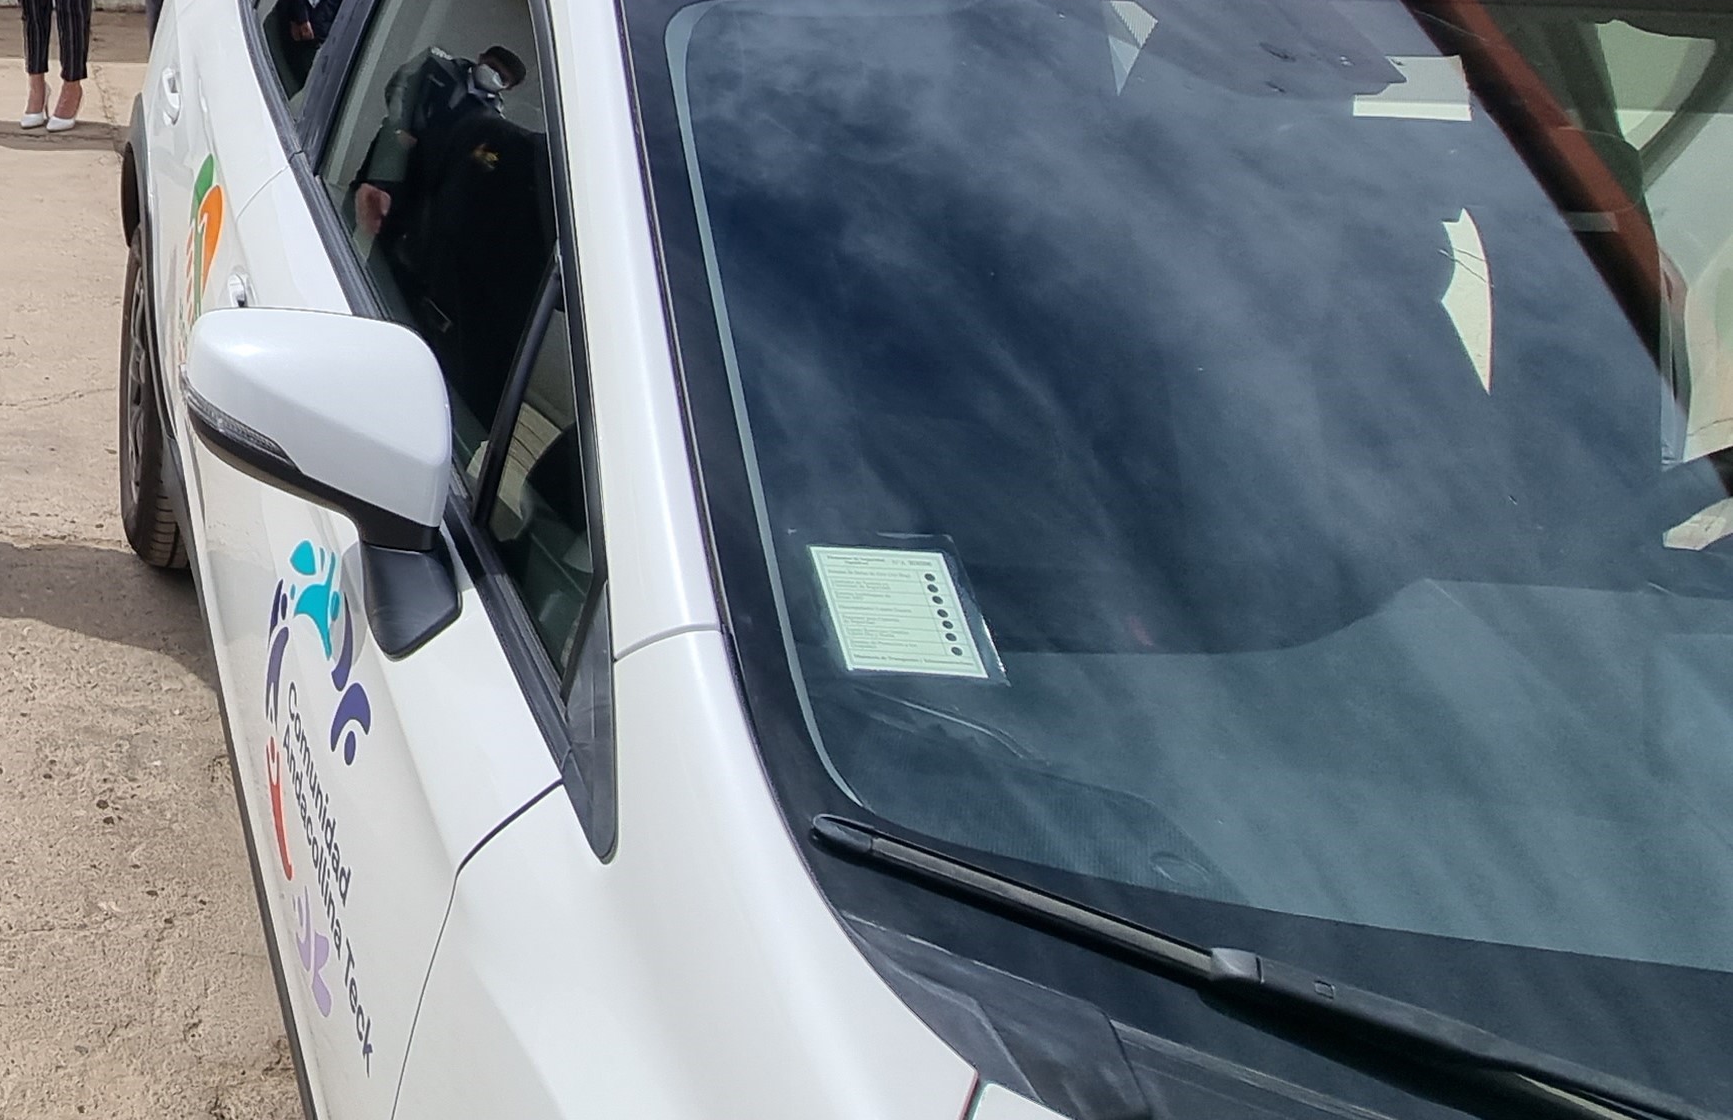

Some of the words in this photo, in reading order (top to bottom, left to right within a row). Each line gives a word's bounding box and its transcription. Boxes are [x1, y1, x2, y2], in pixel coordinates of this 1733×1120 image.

[281, 722, 343, 960] Andacollina
[343, 941, 374, 1078] Teck
[288, 681, 352, 908] Comunidad
